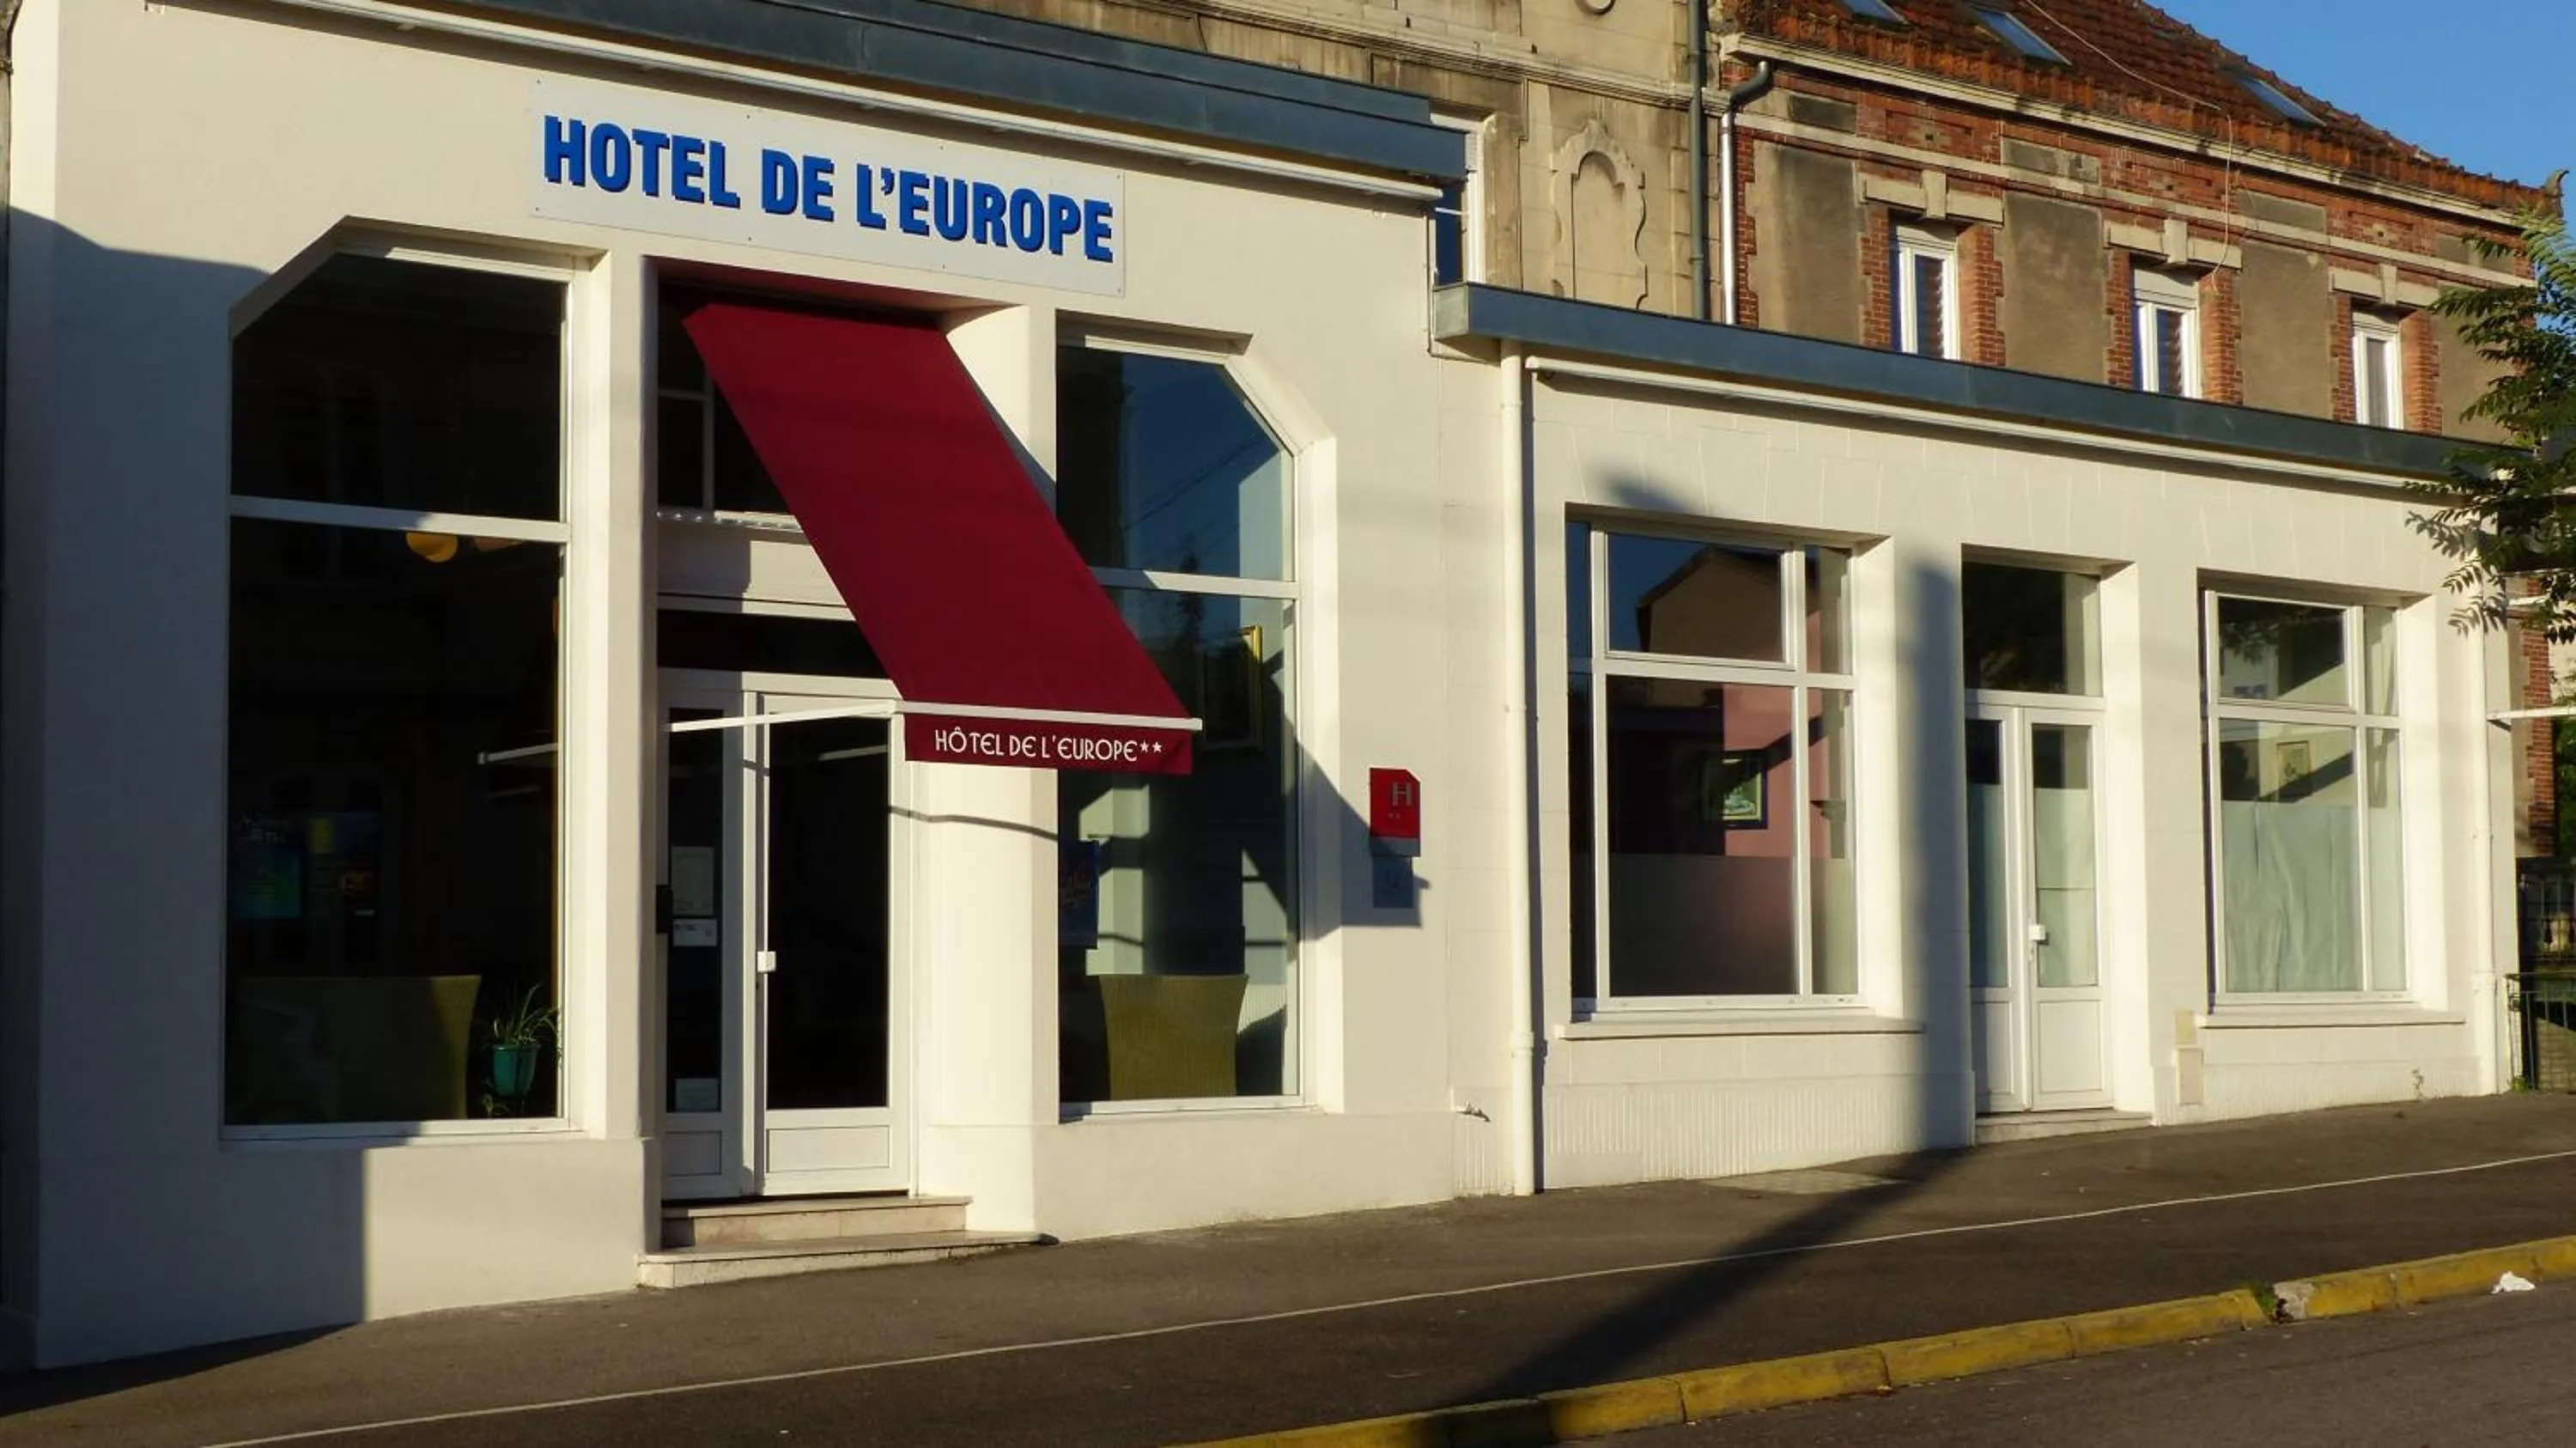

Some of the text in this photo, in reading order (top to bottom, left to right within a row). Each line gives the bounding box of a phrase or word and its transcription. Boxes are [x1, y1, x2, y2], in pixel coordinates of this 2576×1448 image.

[544, 114, 1114, 263] HOTEL DE L'EUROPE
[934, 727, 1004, 757] HÔTEL
[1010, 735, 1036, 757] DE
[1391, 782, 1413, 806] H
